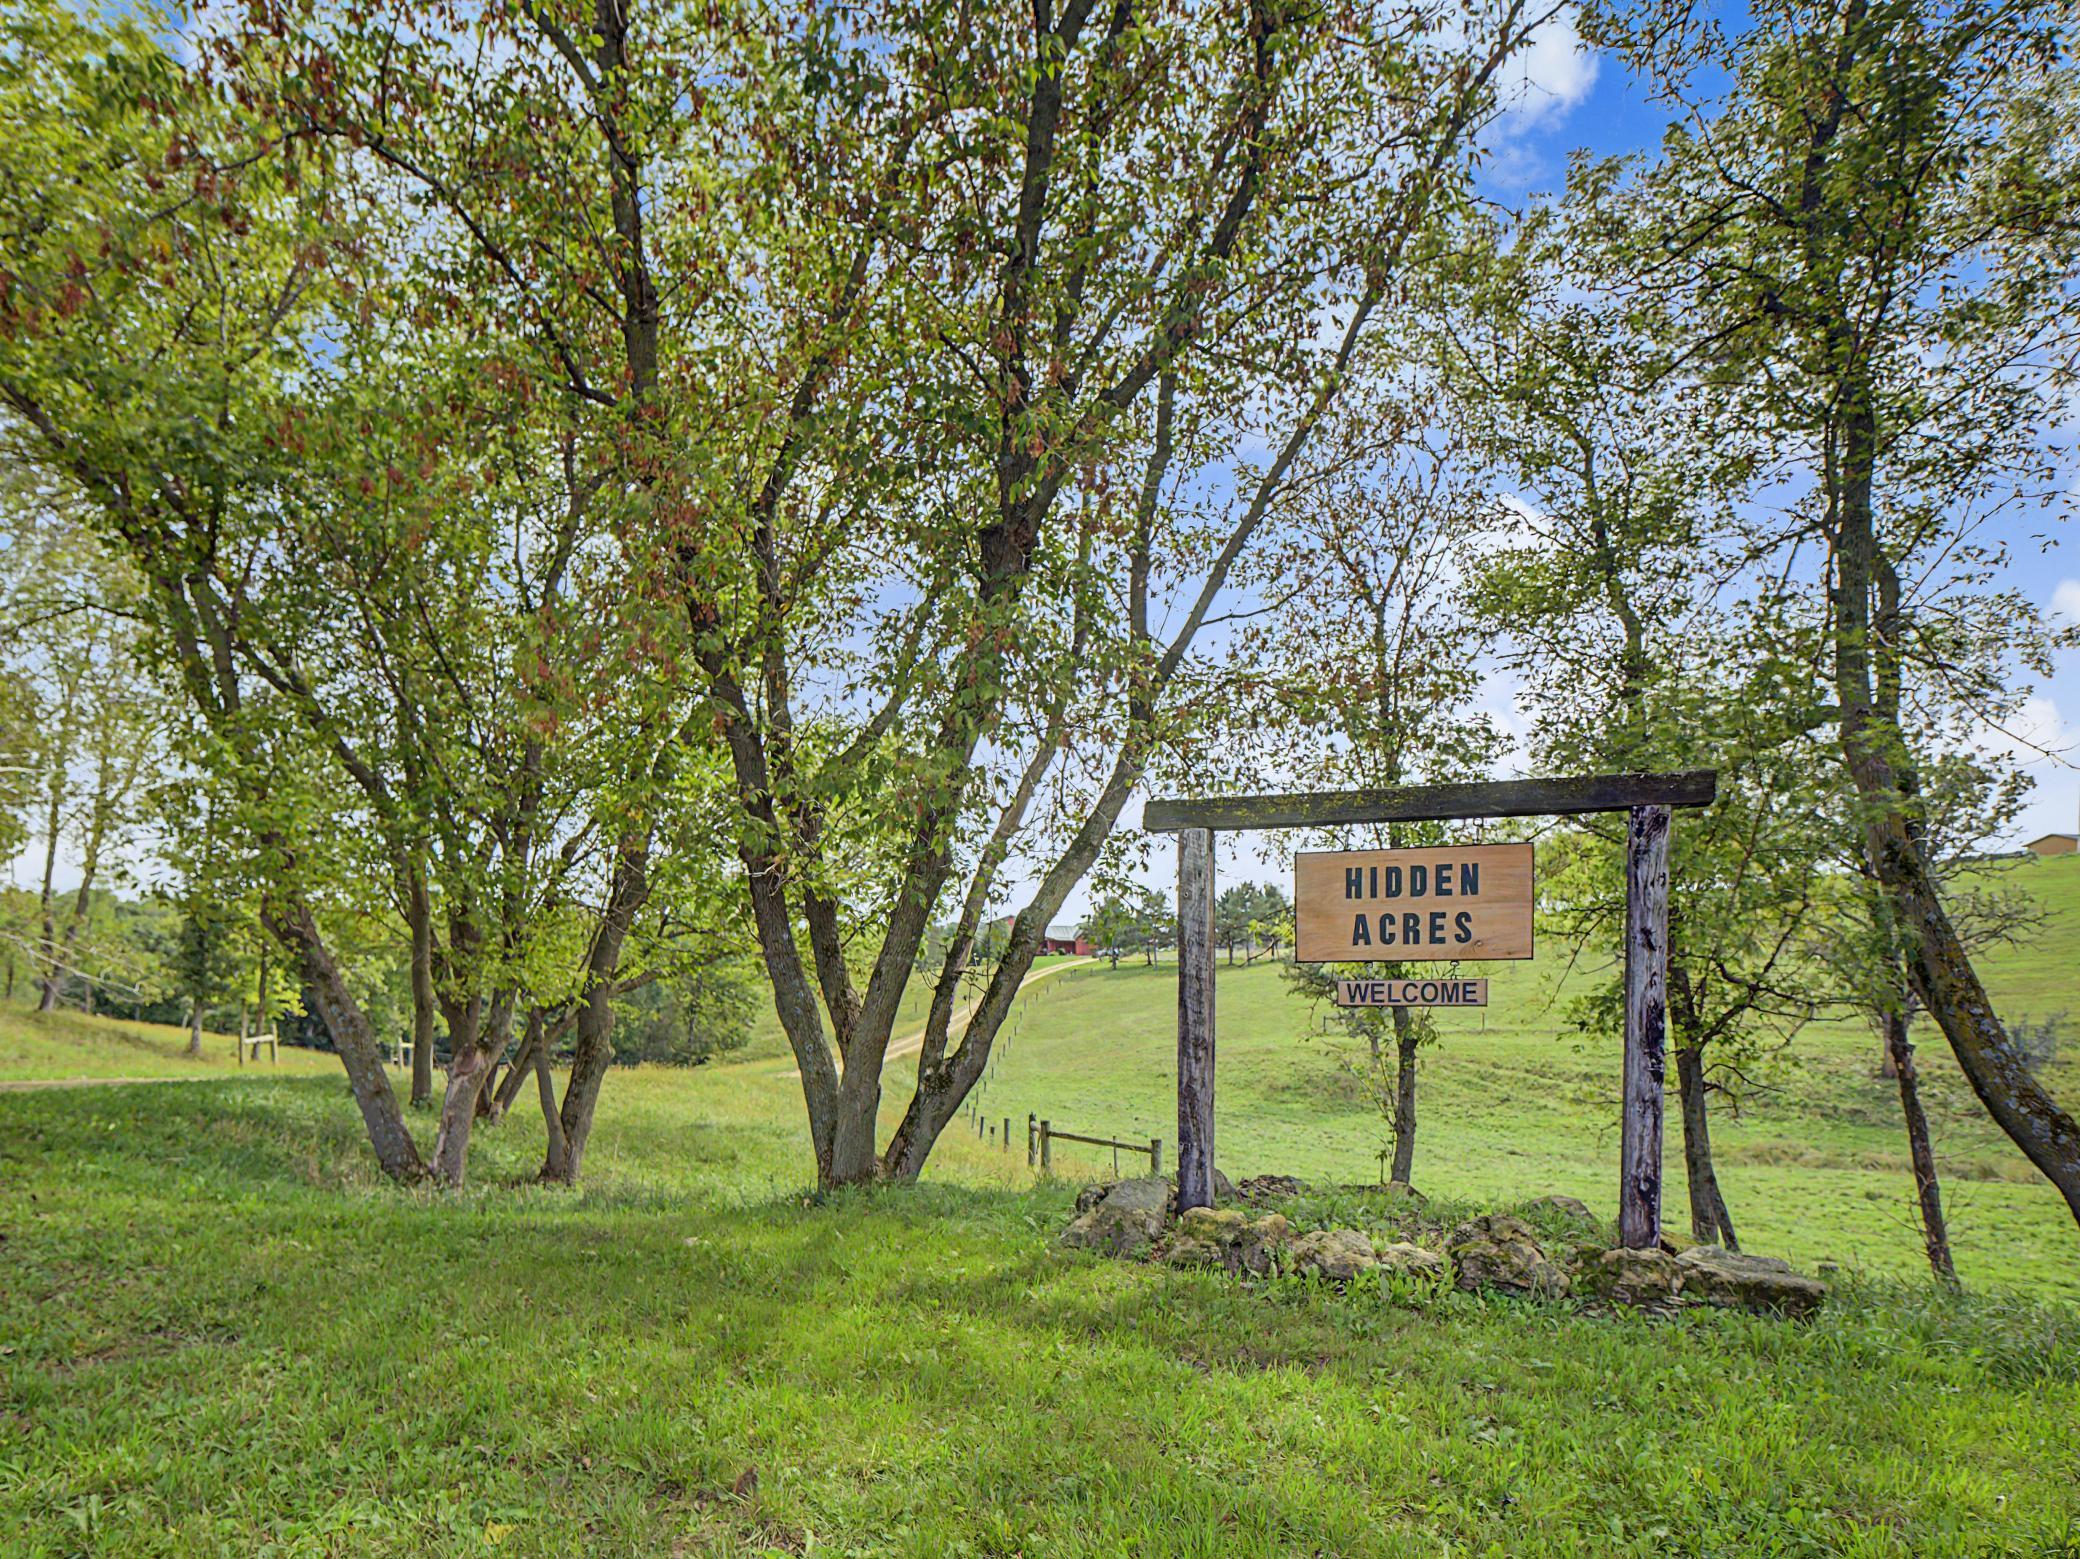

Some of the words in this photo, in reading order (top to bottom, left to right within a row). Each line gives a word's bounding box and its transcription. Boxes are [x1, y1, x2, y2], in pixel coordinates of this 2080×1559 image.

[1345, 863, 1479, 899] HIDDEN
[1352, 911, 1473, 946] ACRES
[1346, 982, 1478, 1003] WELCOME
